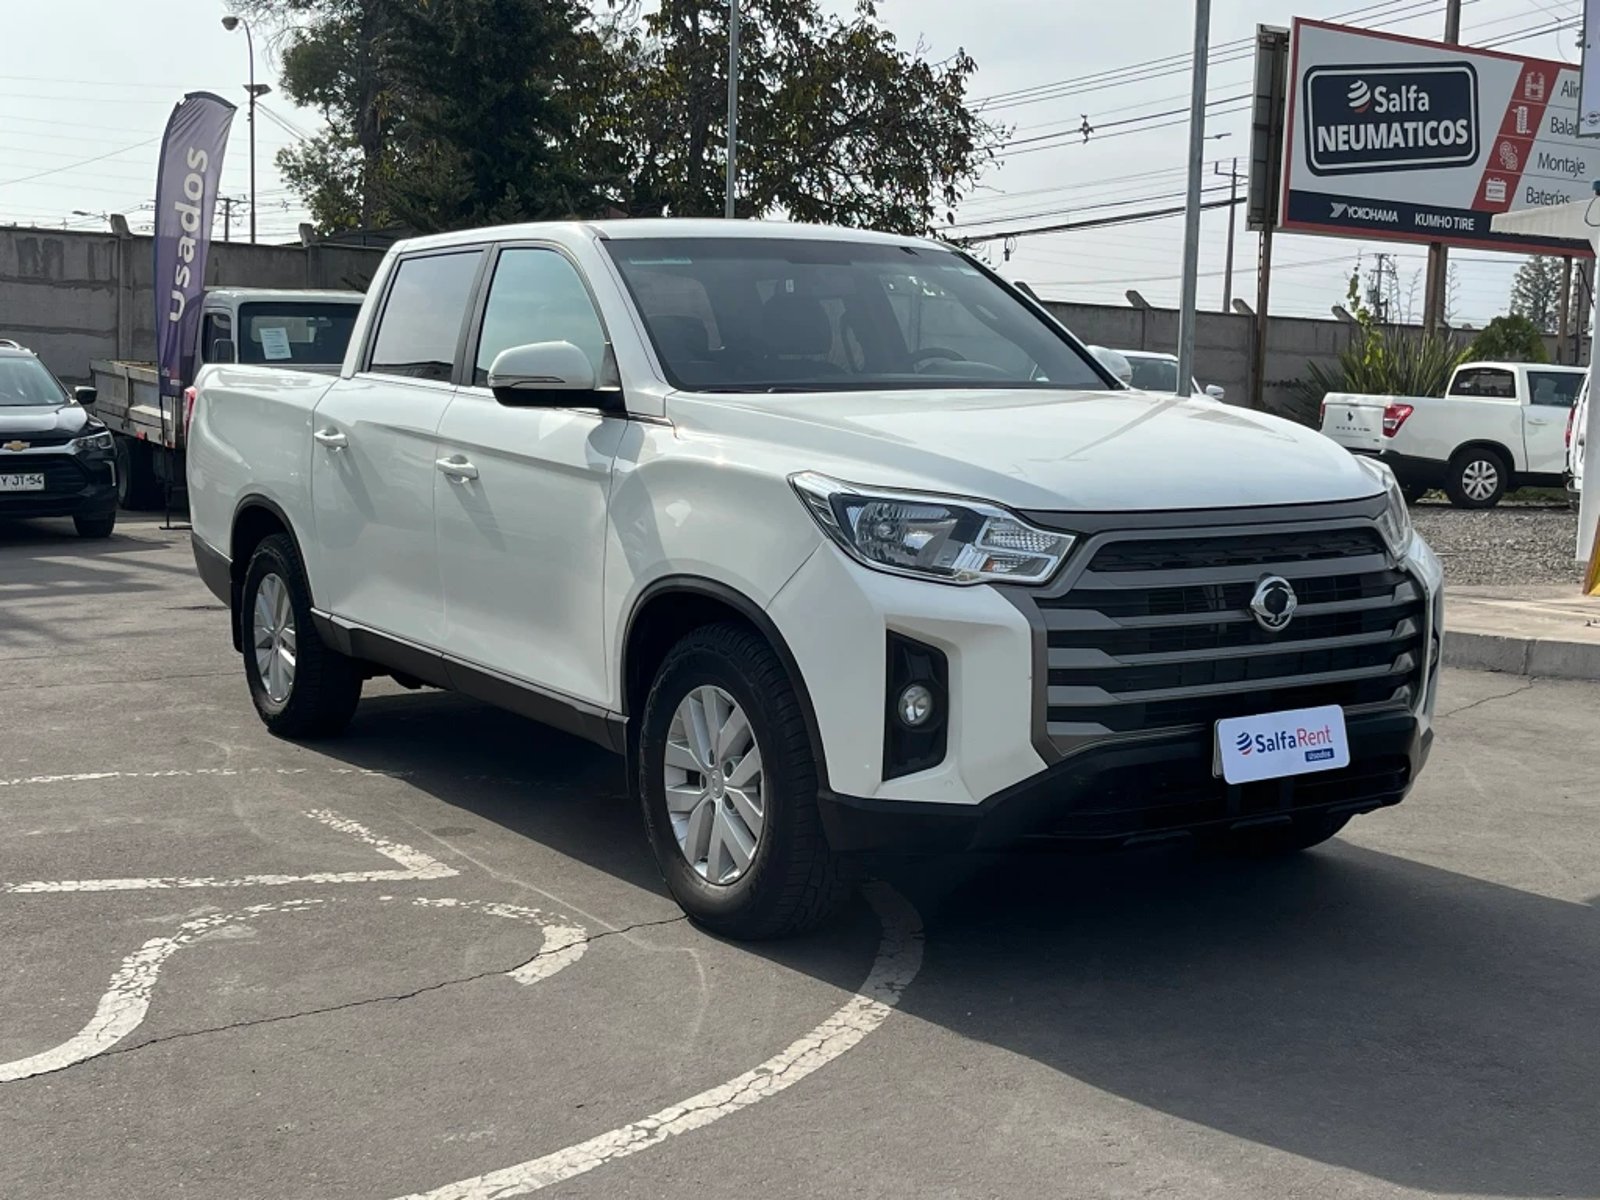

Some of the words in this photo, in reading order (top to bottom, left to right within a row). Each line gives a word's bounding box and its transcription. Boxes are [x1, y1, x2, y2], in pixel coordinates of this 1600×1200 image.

[1374, 85, 1429, 113] Salfa
[1317, 119, 1468, 152] NEUMATICOS
[1550, 116, 1578, 136] Bala
[1537, 152, 1585, 178] Montaje
[1347, 206, 1398, 223] YOKOHAMA
[1415, 212, 1451, 229] KUMHO
[1453, 216, 1475, 231] TIRE
[169, 146, 209, 322] usados
[1255, 725, 1333, 753] SalfaRent
